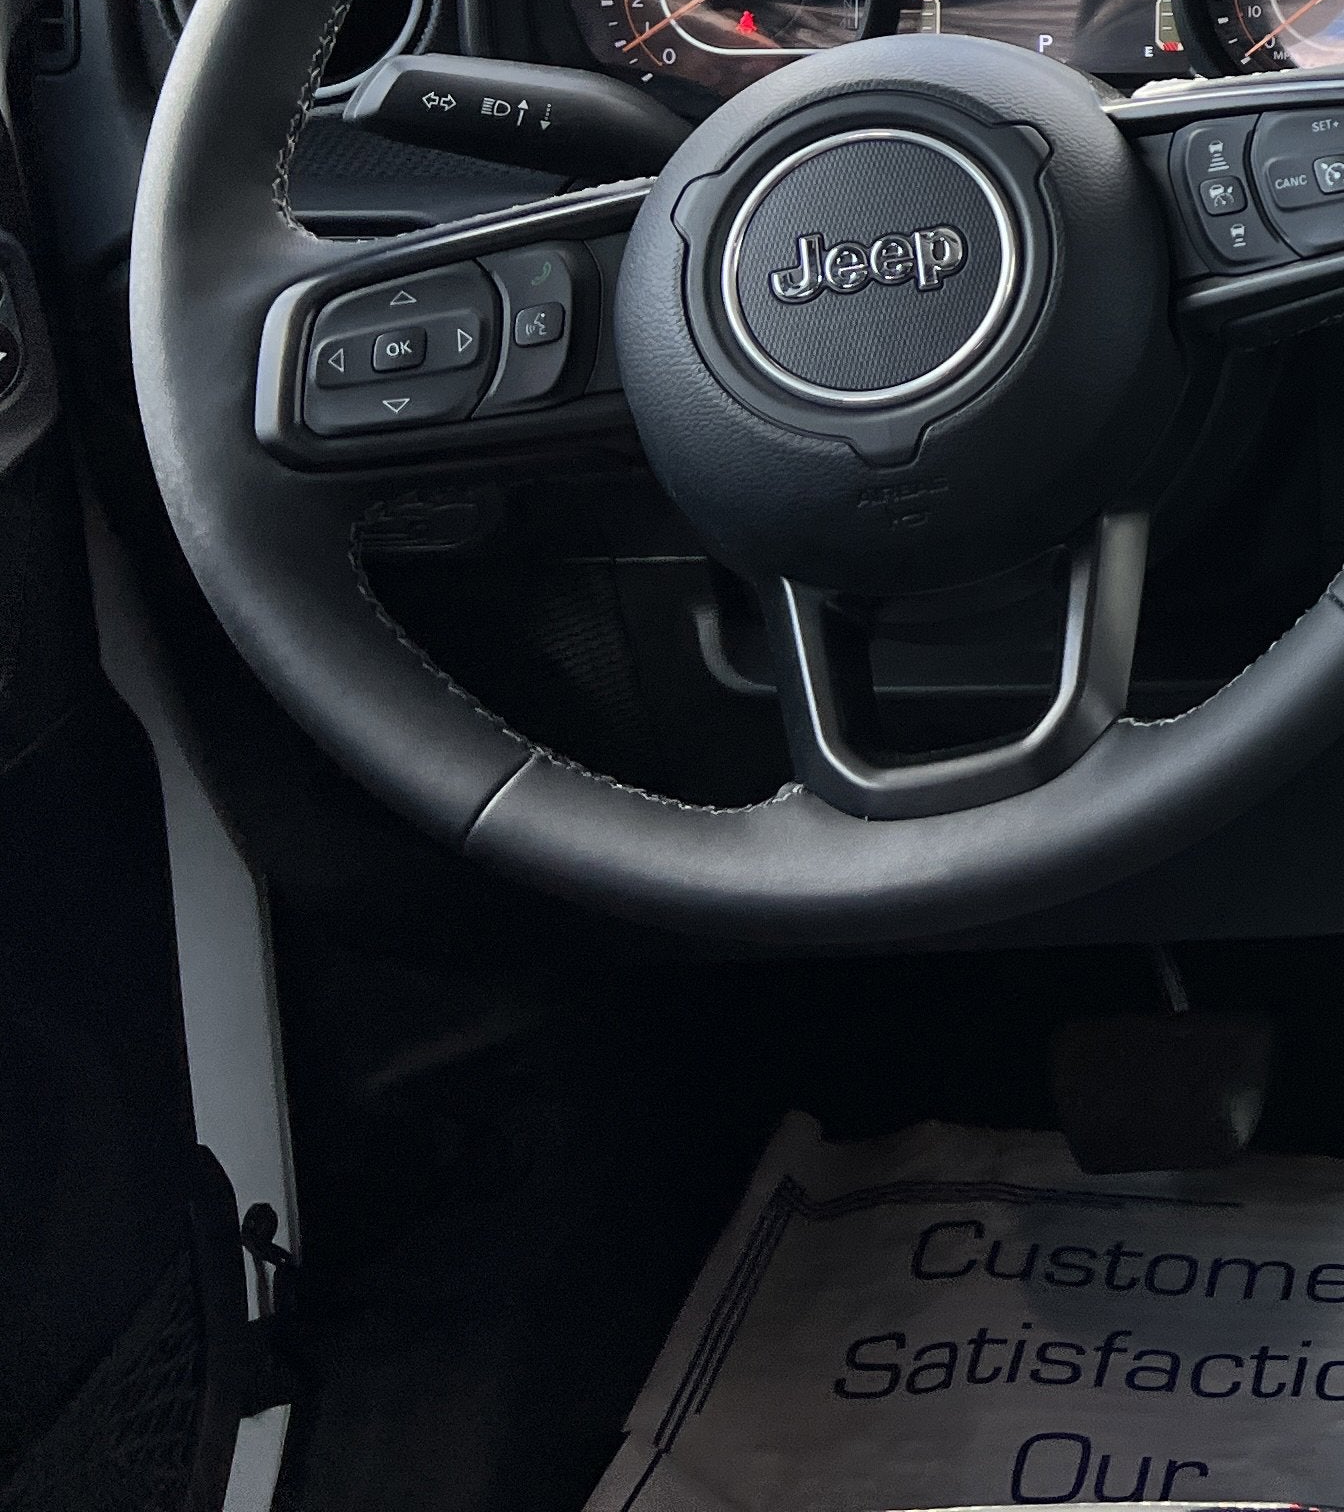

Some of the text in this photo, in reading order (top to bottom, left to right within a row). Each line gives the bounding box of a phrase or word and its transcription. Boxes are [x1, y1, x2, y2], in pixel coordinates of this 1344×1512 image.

[1248, 6, 1262, 18] 10
[1038, 35, 1053, 53] P
[1144, 46, 1154, 58] E
[662, 47, 677, 65] 0
[1275, 174, 1308, 190] CANC
[769, 223, 969, 304] Jeep
[386, 340, 413, 357] OK
[1010, 1431, 1210, 1506] Our
